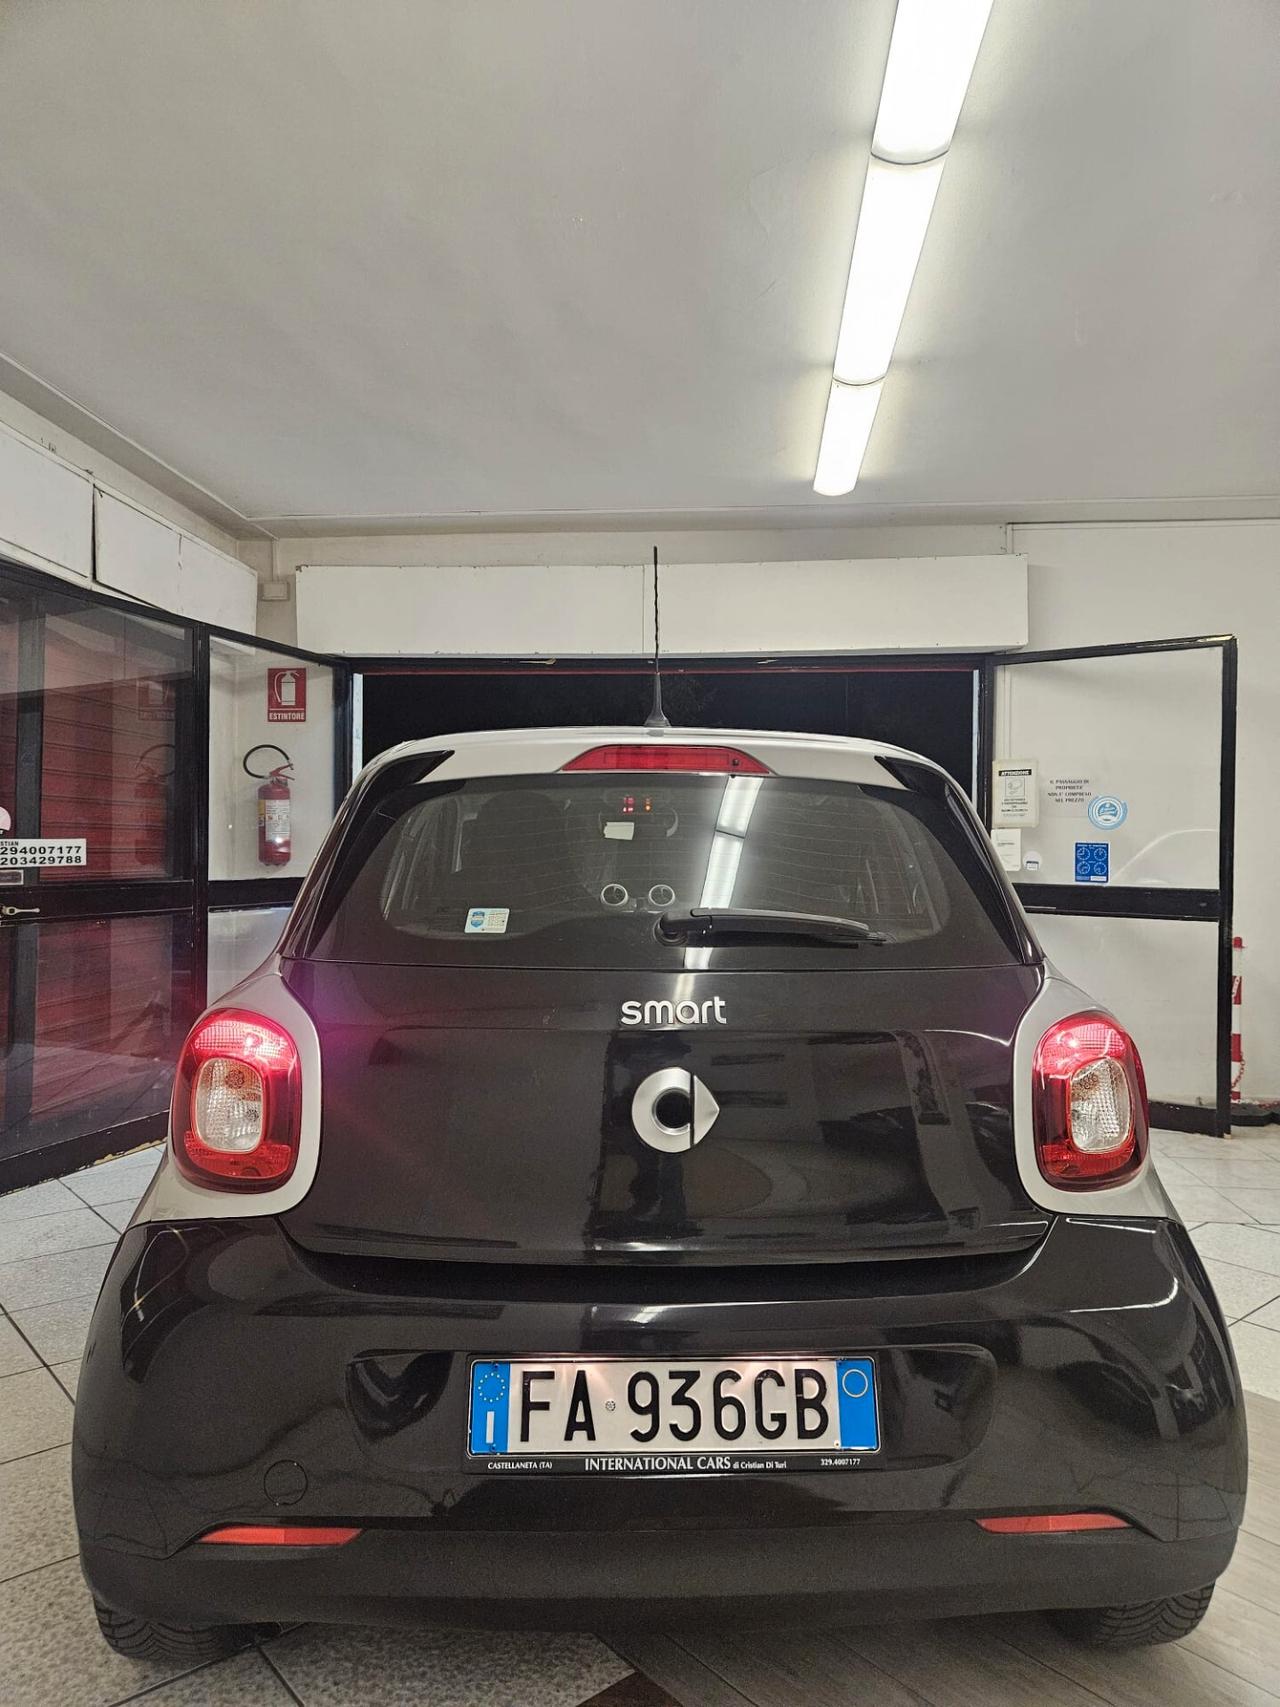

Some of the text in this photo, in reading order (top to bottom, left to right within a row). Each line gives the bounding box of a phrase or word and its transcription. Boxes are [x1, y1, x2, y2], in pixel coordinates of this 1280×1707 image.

[269, 712, 304, 720] ESTINTORE
[0, 846, 82, 855] 294007177
[0, 856, 82, 865] 203429788
[621, 996, 727, 1025] smart
[519, 1368, 829, 1442] FA 936GB
[487, 1461, 553, 1470] CASTELLANETA (TA)
[585, 1456, 787, 1471] INTERNATIONAL CARS di Cristian Di Turi
[820, 1458, 861, 1466] 329.4007177
